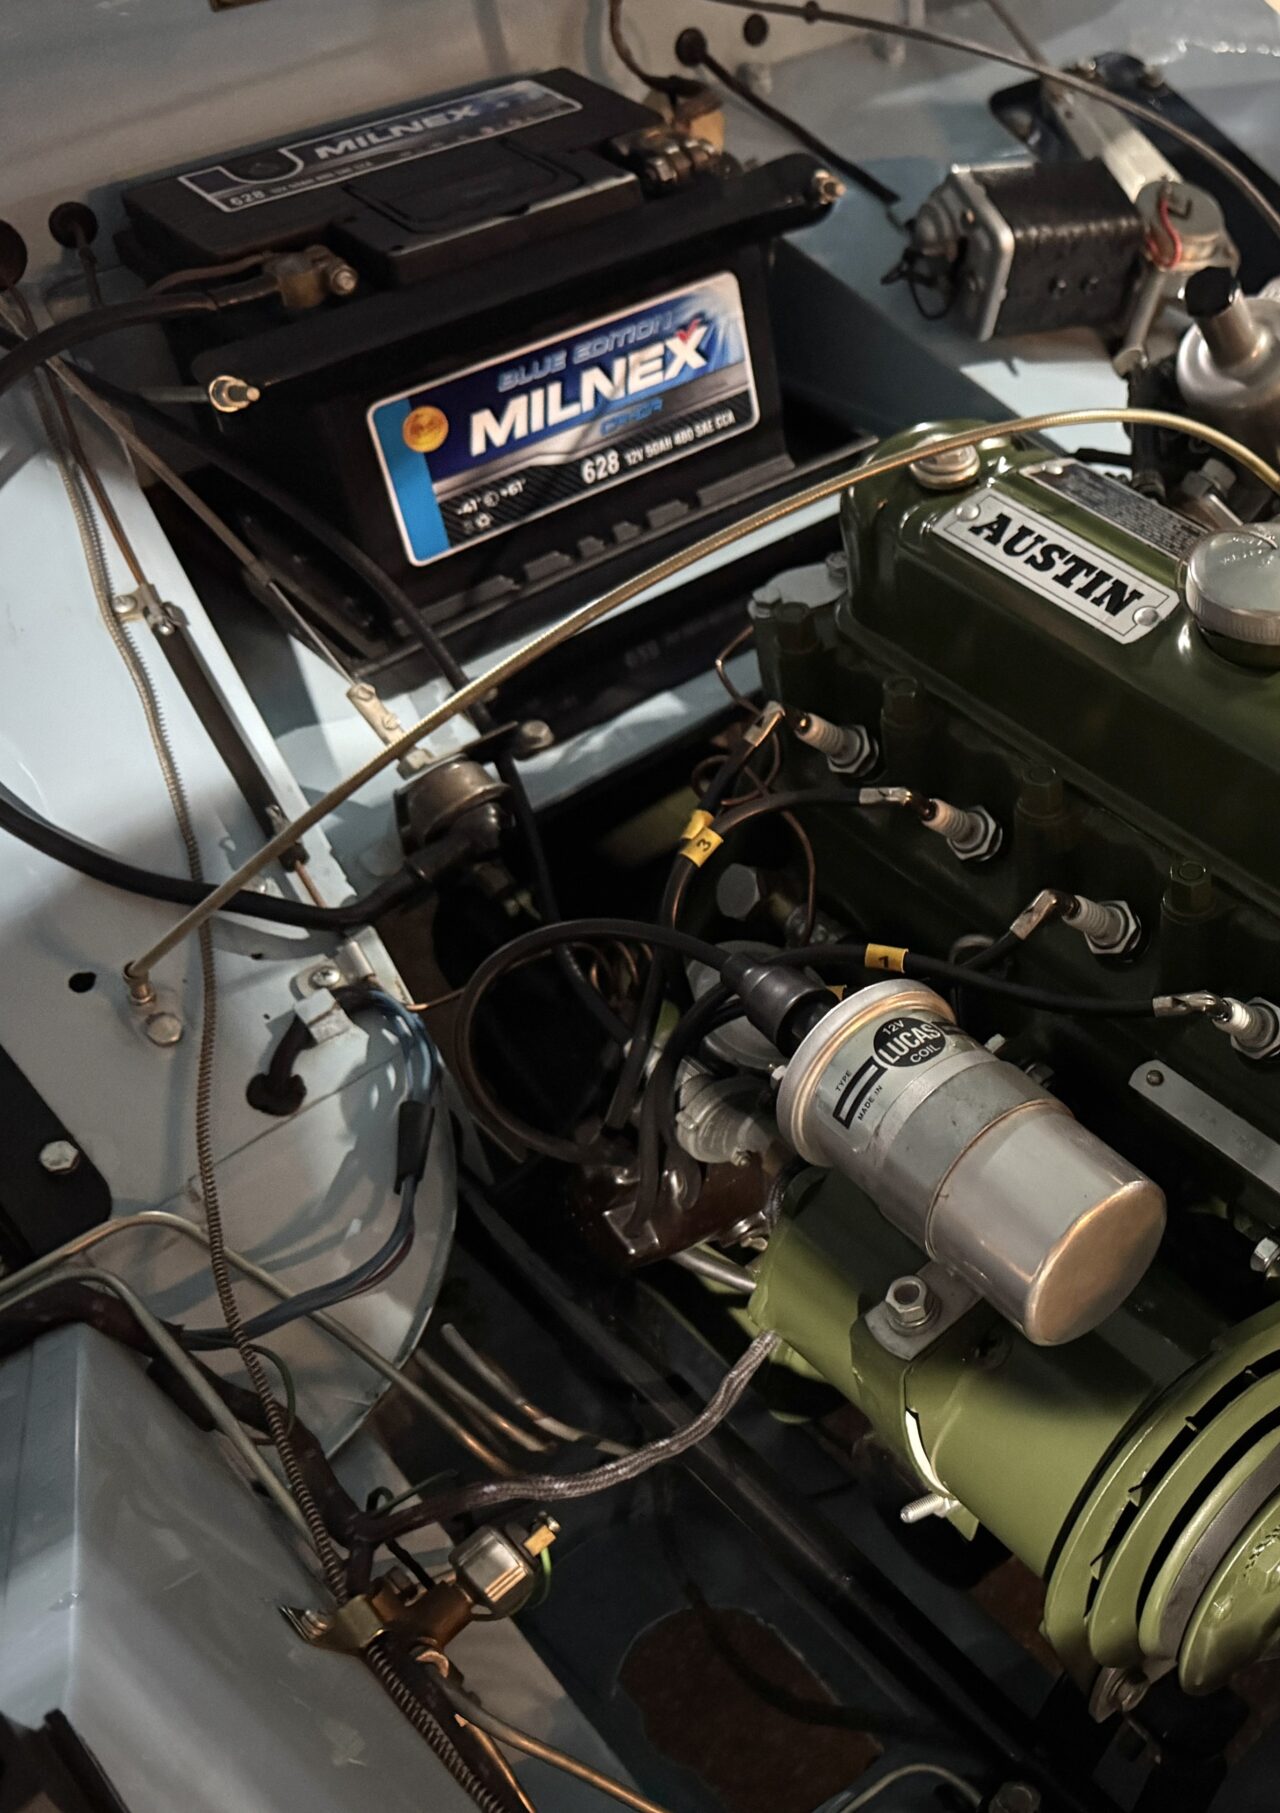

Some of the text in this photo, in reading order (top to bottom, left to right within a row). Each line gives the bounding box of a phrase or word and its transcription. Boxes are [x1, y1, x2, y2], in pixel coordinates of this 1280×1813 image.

[315, 104, 478, 160] MILNEX
[230, 189, 265, 206] 628
[497, 310, 674, 392] BLUE EDITION
[470, 322, 708, 457] MILNEX
[582, 449, 620, 484] 628
[624, 449, 645, 466] 12V
[968, 511, 1144, 617] AUSTIN
[696, 838, 712, 852] 3
[878, 1021, 941, 1064] LUCAS
[882, 1019, 904, 1035] 12V
[909, 1043, 942, 1063] COIL
[834, 1069, 853, 1092] TYPE
[857, 1084, 884, 1121] MADE IN
